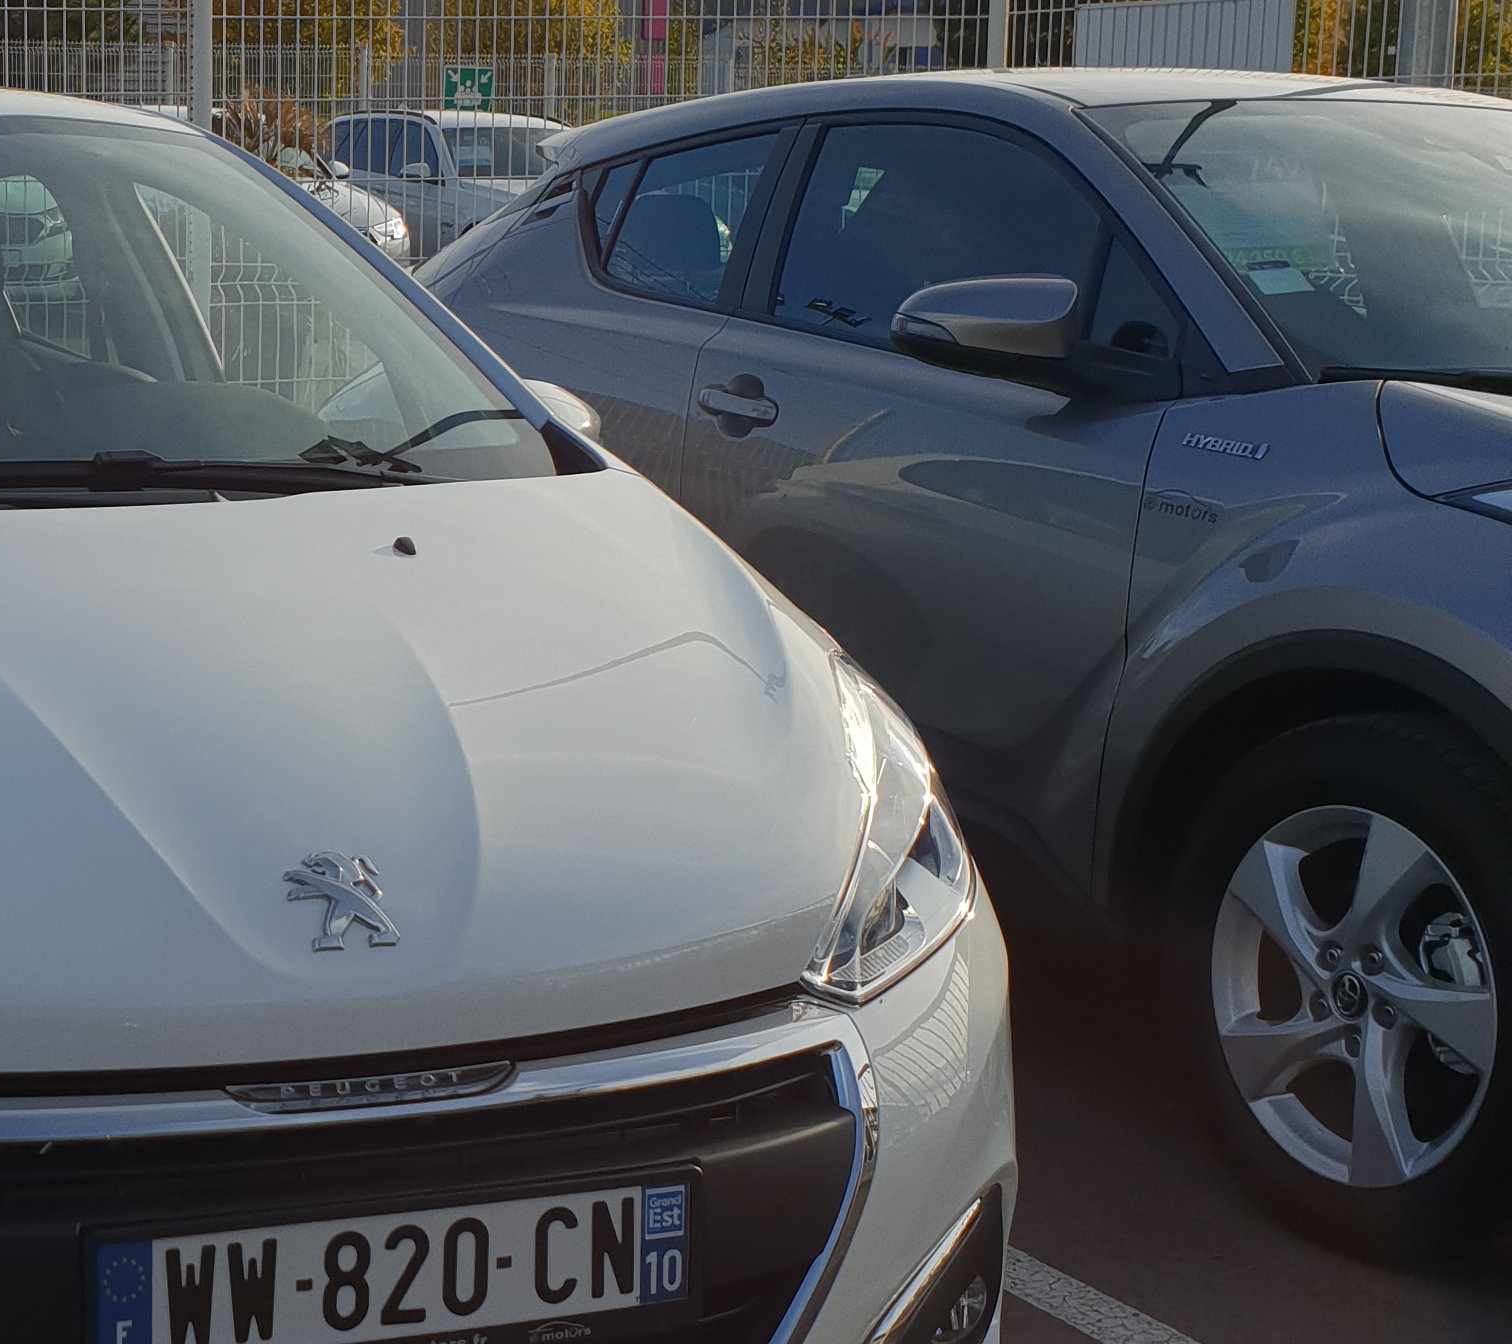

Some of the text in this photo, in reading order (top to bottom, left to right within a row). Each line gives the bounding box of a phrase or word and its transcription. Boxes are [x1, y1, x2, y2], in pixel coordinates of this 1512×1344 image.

[1181, 432, 1254, 458] HYBRID
[279, 1070, 463, 1099] PEUGEOT
[649, 1194, 682, 1208] Grand
[649, 1206, 682, 1228] Est
[645, 1248, 683, 1295] 10
